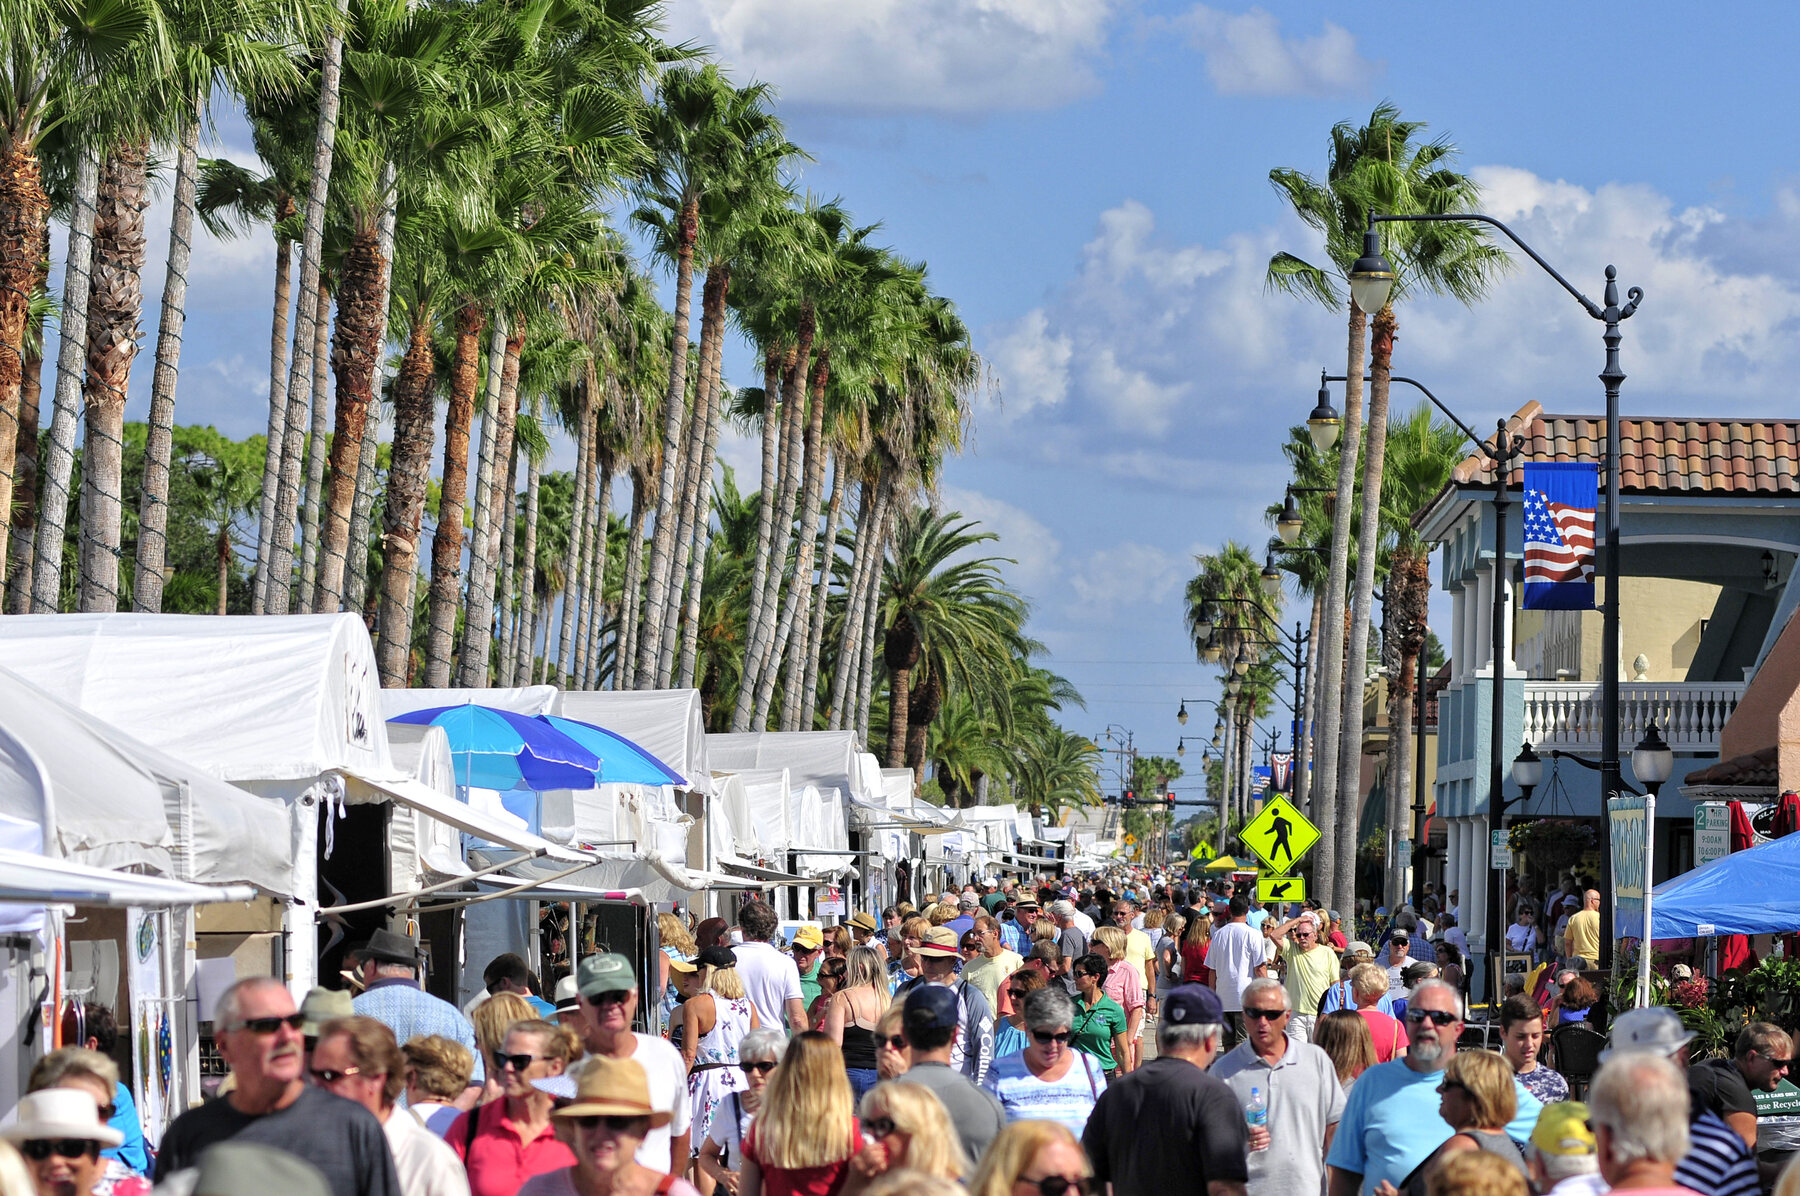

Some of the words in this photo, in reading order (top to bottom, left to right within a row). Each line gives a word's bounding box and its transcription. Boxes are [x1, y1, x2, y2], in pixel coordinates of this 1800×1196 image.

[1697, 810, 1705, 826] 2
[1713, 809, 1723, 817] HR
[1758, 810, 1774, 820] ISLA
[1707, 819, 1728, 827] PARKING
[1698, 846, 1704, 855] TO
[977, 1034, 992, 1086] Colum
